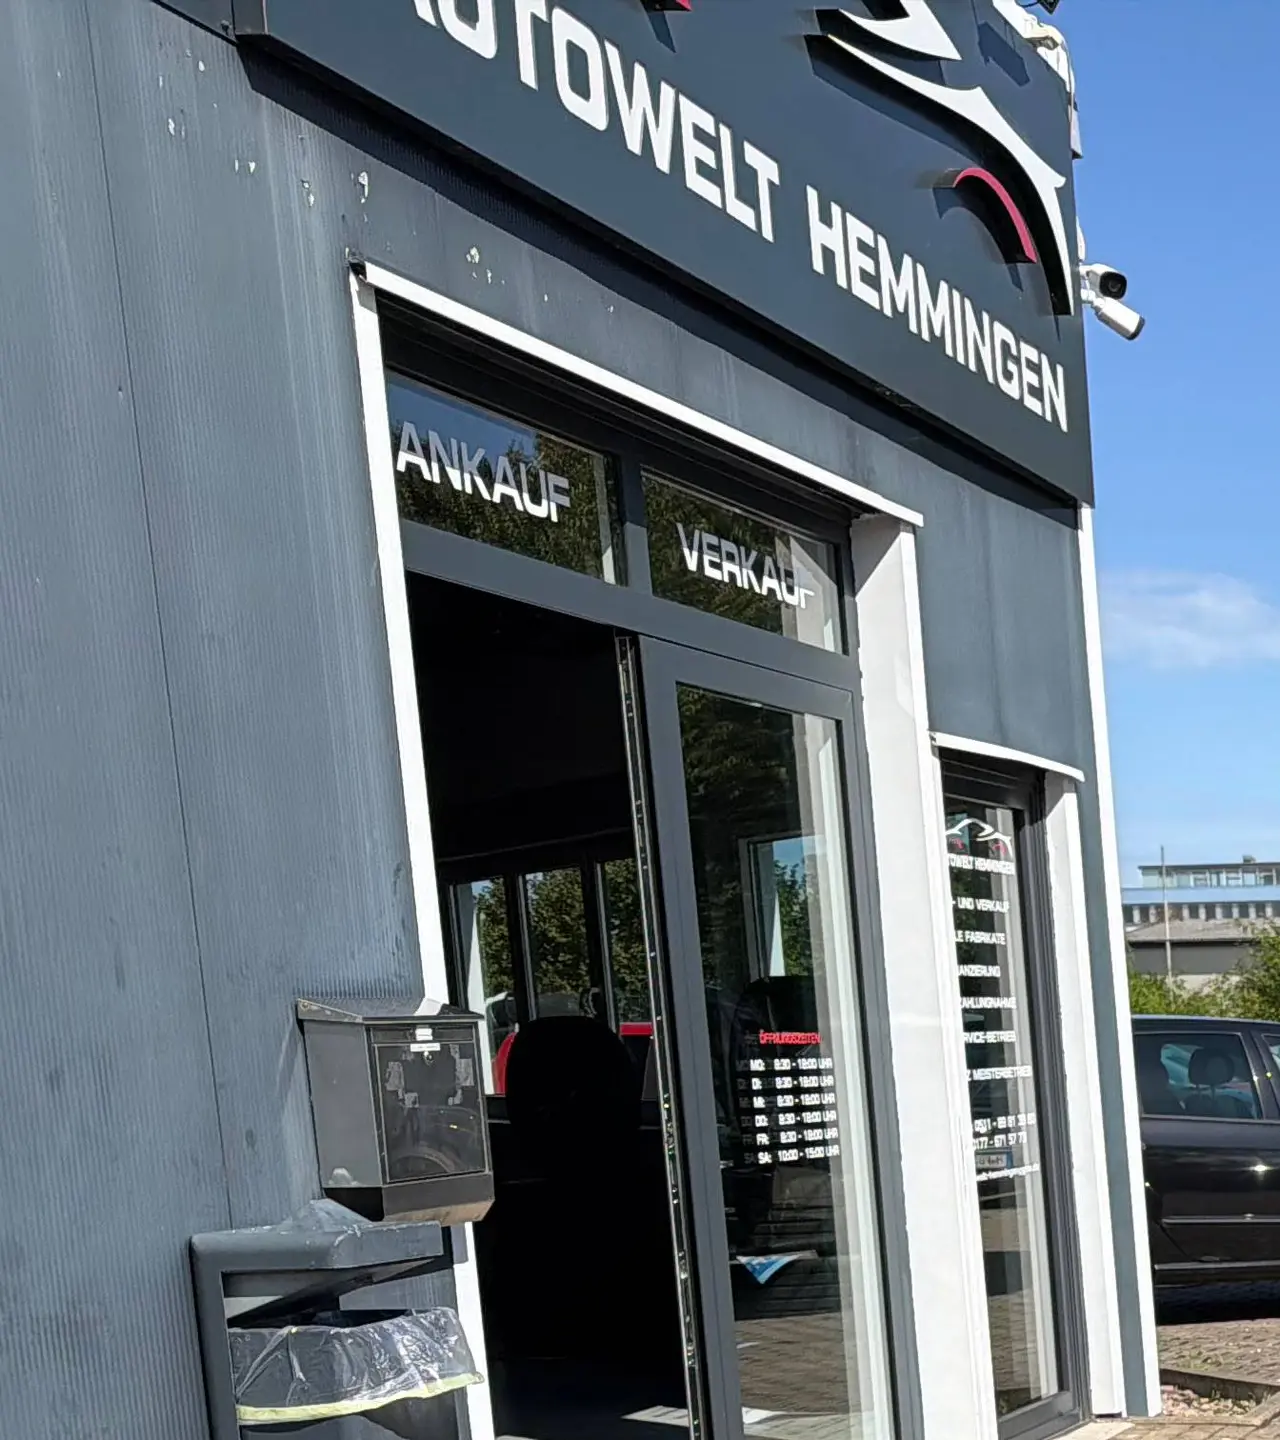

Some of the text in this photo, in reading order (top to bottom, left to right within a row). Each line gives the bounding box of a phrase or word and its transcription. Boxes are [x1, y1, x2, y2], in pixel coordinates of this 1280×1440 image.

[414, 0, 1068, 432] UTOWELT HEMMINGEN
[396, 422, 571, 523] ANKAUF
[677, 522, 815, 609] VERKAUF
[818, 1058, 833, 1069] UHR
[820, 1075, 834, 1087] UHR
[821, 1092, 836, 1104] UHR
[822, 1110, 837, 1121] UHR
[824, 1127, 838, 1139] UHR
[825, 1145, 840, 1157] UHR
